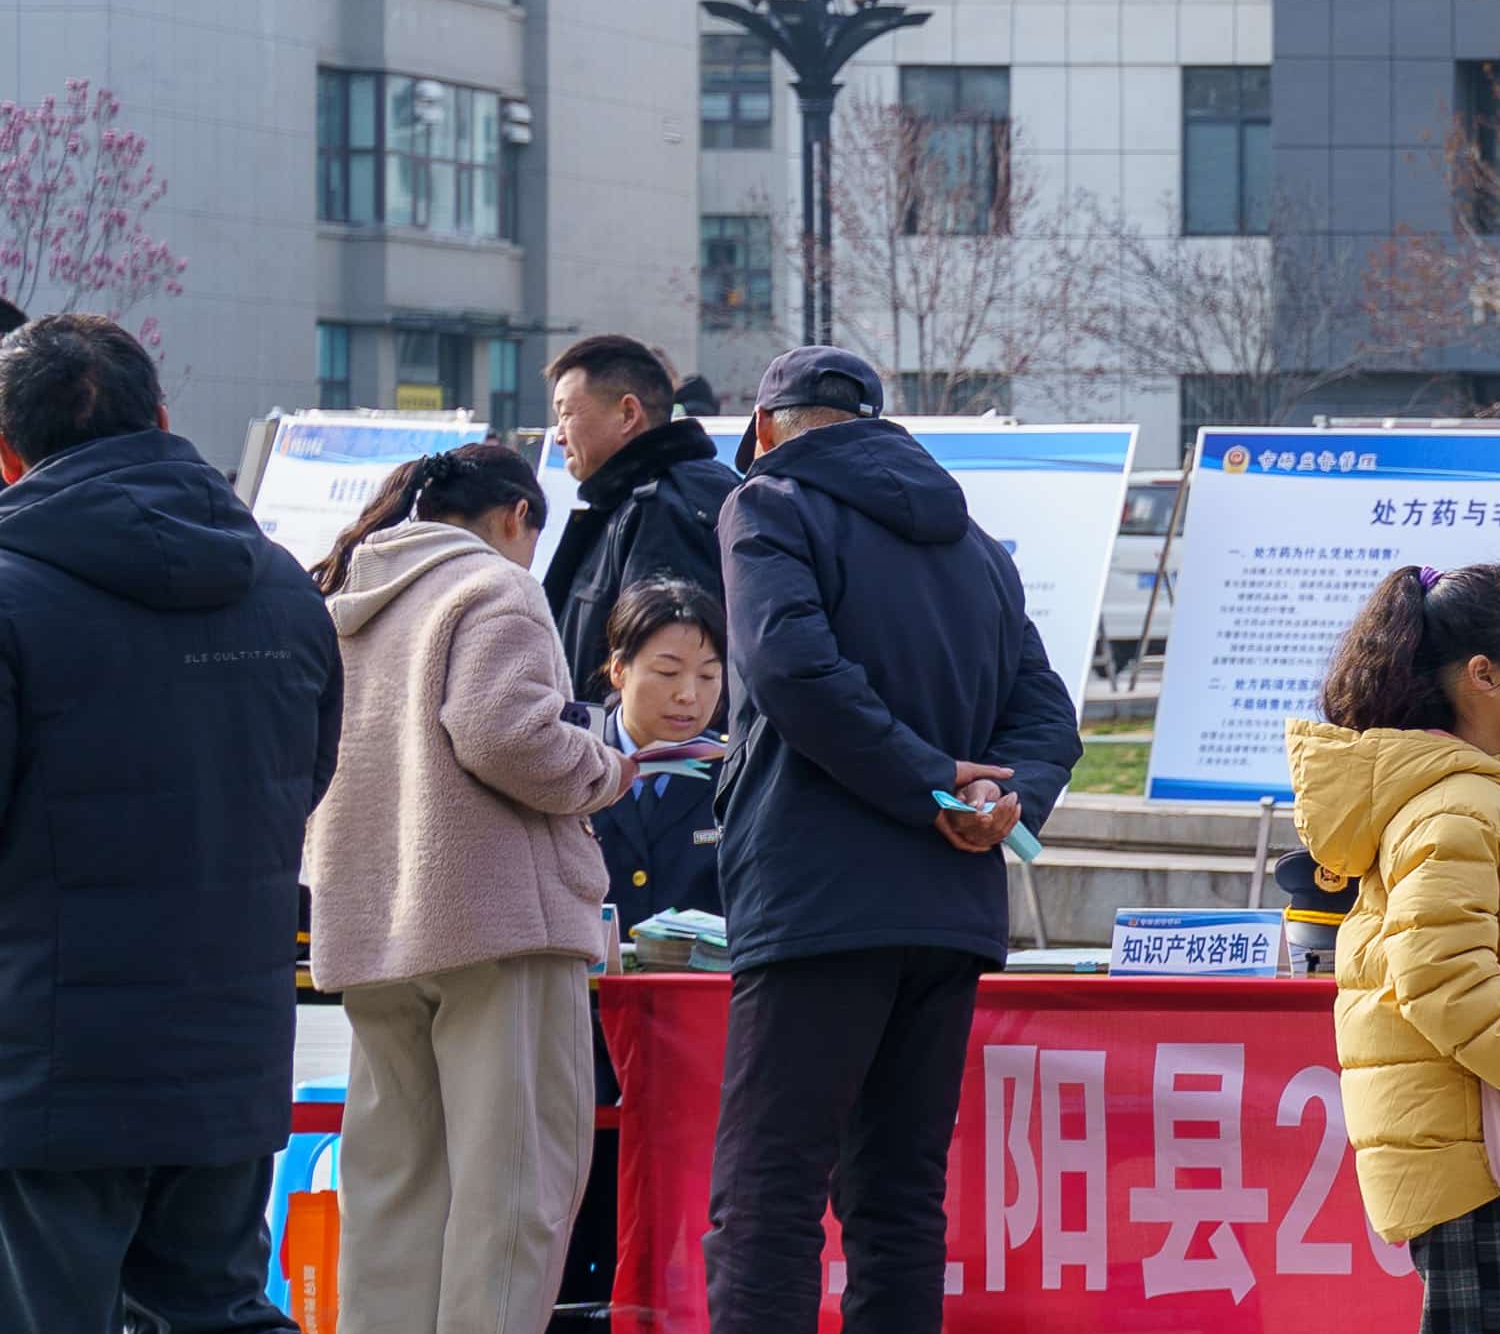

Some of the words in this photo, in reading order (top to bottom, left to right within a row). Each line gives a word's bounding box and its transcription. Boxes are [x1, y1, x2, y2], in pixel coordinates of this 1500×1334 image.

[1121, 933, 1270, 965] 知识产权咨询台
